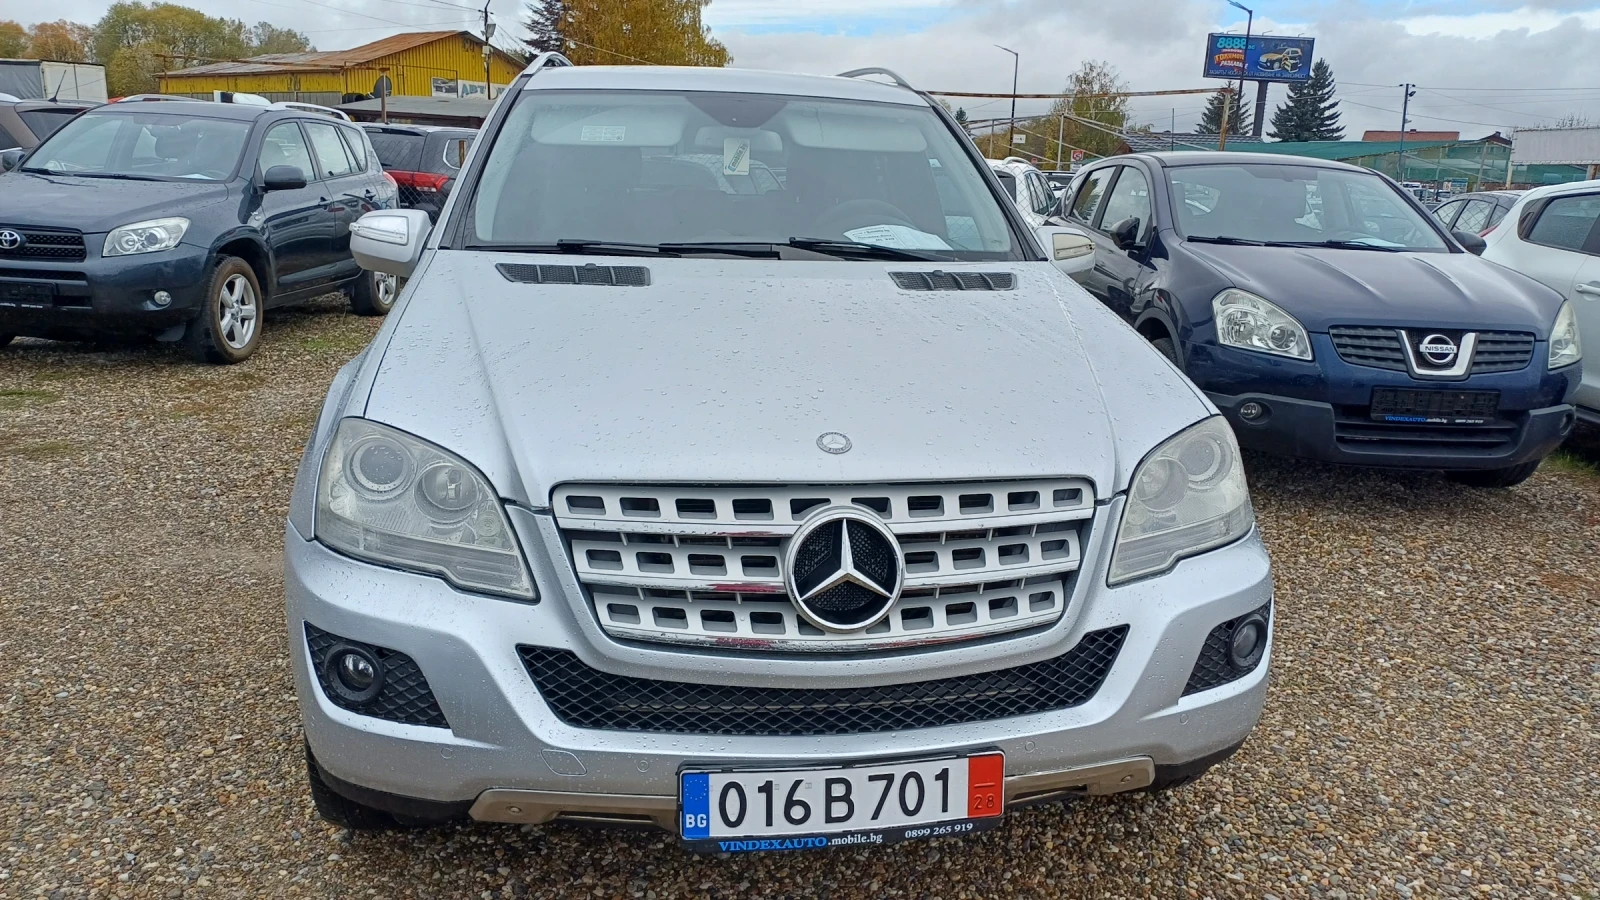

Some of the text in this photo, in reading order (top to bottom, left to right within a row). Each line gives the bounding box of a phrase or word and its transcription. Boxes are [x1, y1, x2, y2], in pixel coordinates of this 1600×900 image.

[685, 813, 707, 828] BG
[973, 794, 995, 809] 28
[905, 827, 930, 838] 0899
[932, 825, 952, 836] 265
[954, 822, 973, 833] 919
